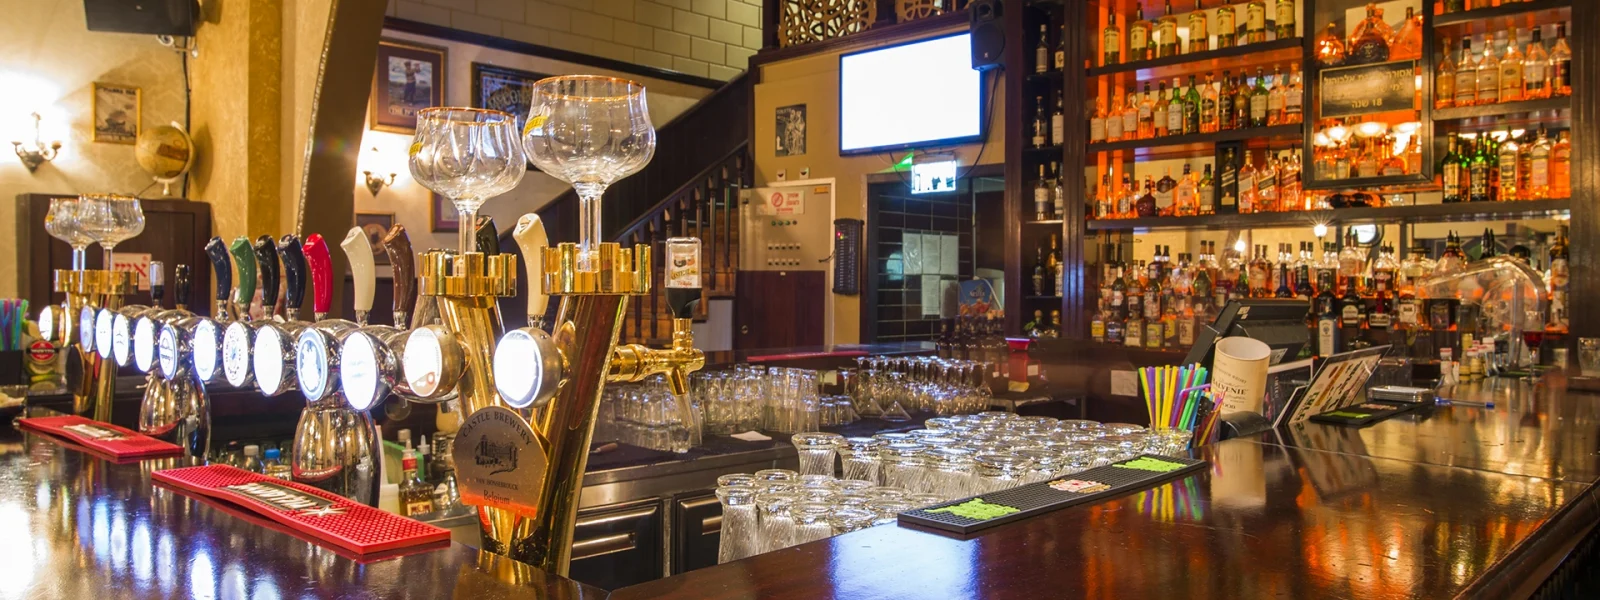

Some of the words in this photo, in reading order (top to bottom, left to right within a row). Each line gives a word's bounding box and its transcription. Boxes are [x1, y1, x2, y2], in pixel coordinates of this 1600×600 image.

[1351, 99, 1369, 109] שנה
[1372, 98, 1383, 107] 18
[462, 410, 491, 438] CASTLE
[494, 410, 532, 446] BREWERY
[483, 489, 510, 505] Belgium
